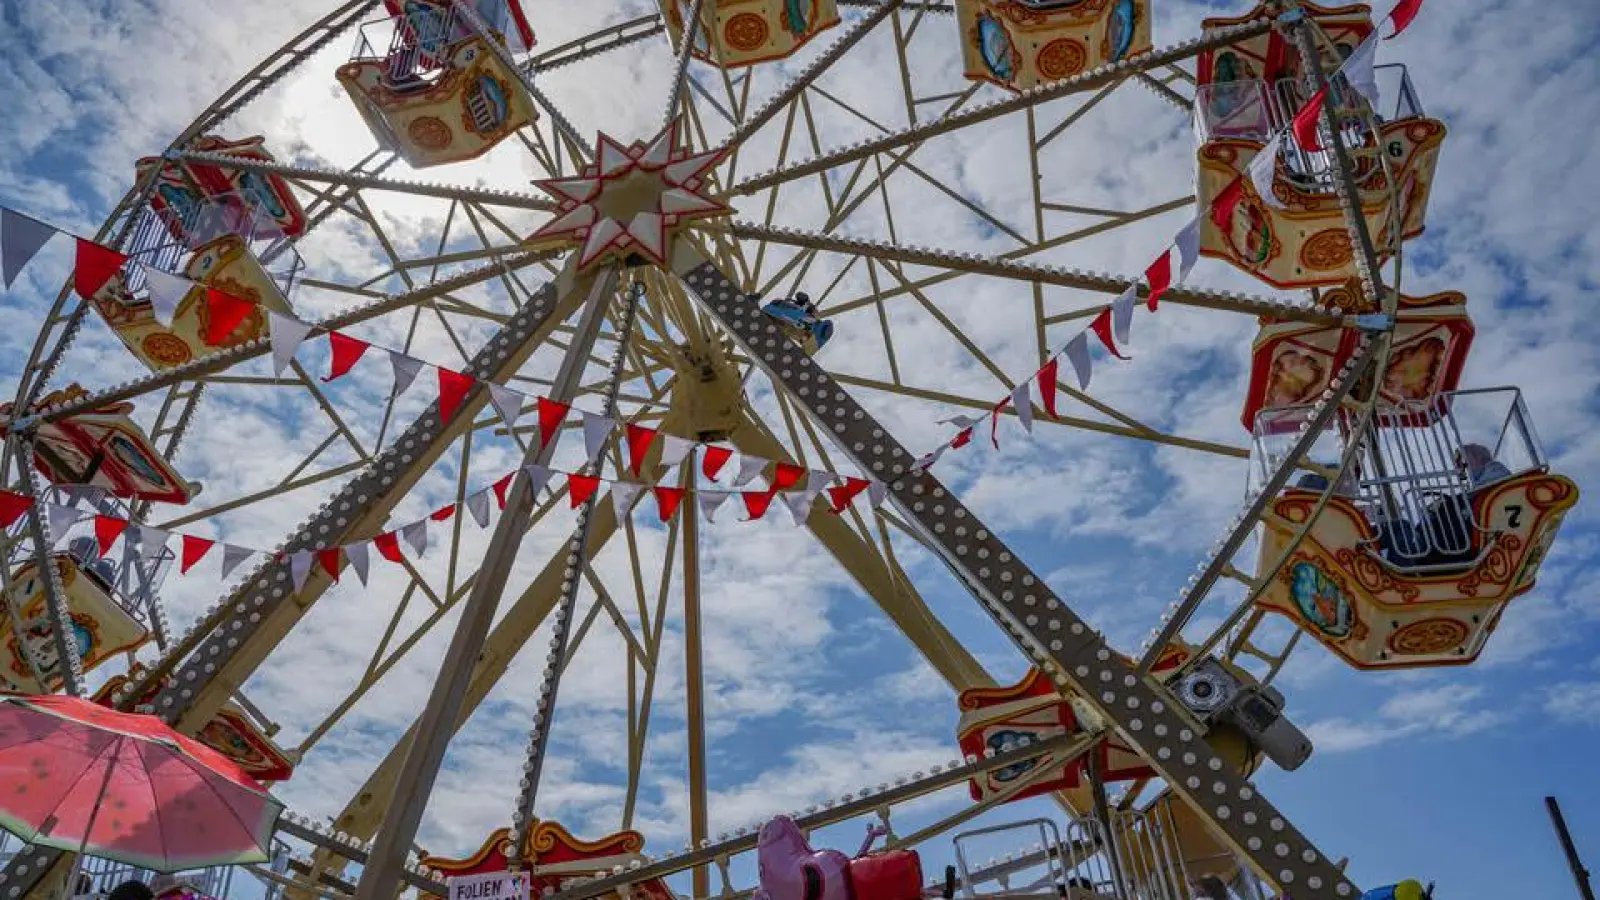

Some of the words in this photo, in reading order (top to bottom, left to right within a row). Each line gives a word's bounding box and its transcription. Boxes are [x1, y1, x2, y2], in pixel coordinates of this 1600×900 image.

[1388, 141, 1402, 157] 6
[1504, 505, 1521, 528] 7
[457, 879, 502, 898] FOLIEN
